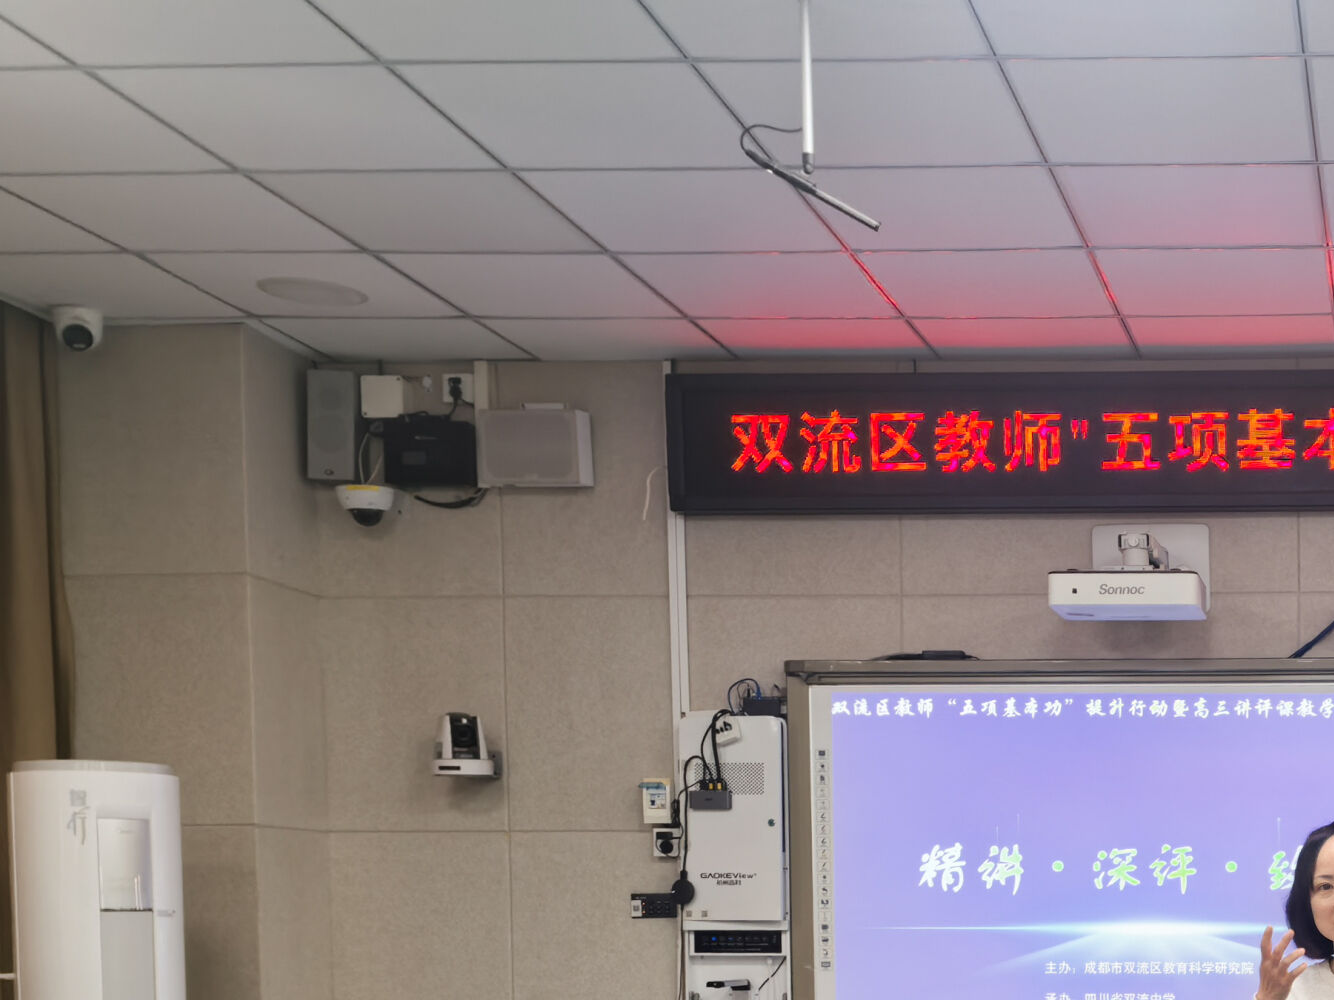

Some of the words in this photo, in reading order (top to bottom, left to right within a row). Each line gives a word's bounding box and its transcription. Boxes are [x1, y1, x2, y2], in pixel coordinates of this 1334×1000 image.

[1098, 583, 1145, 595] Sonnoc
[66, 788, 91, 847] 行
[1044, 961, 1254, 975] 主办：成都市双流区教育科学研究院
